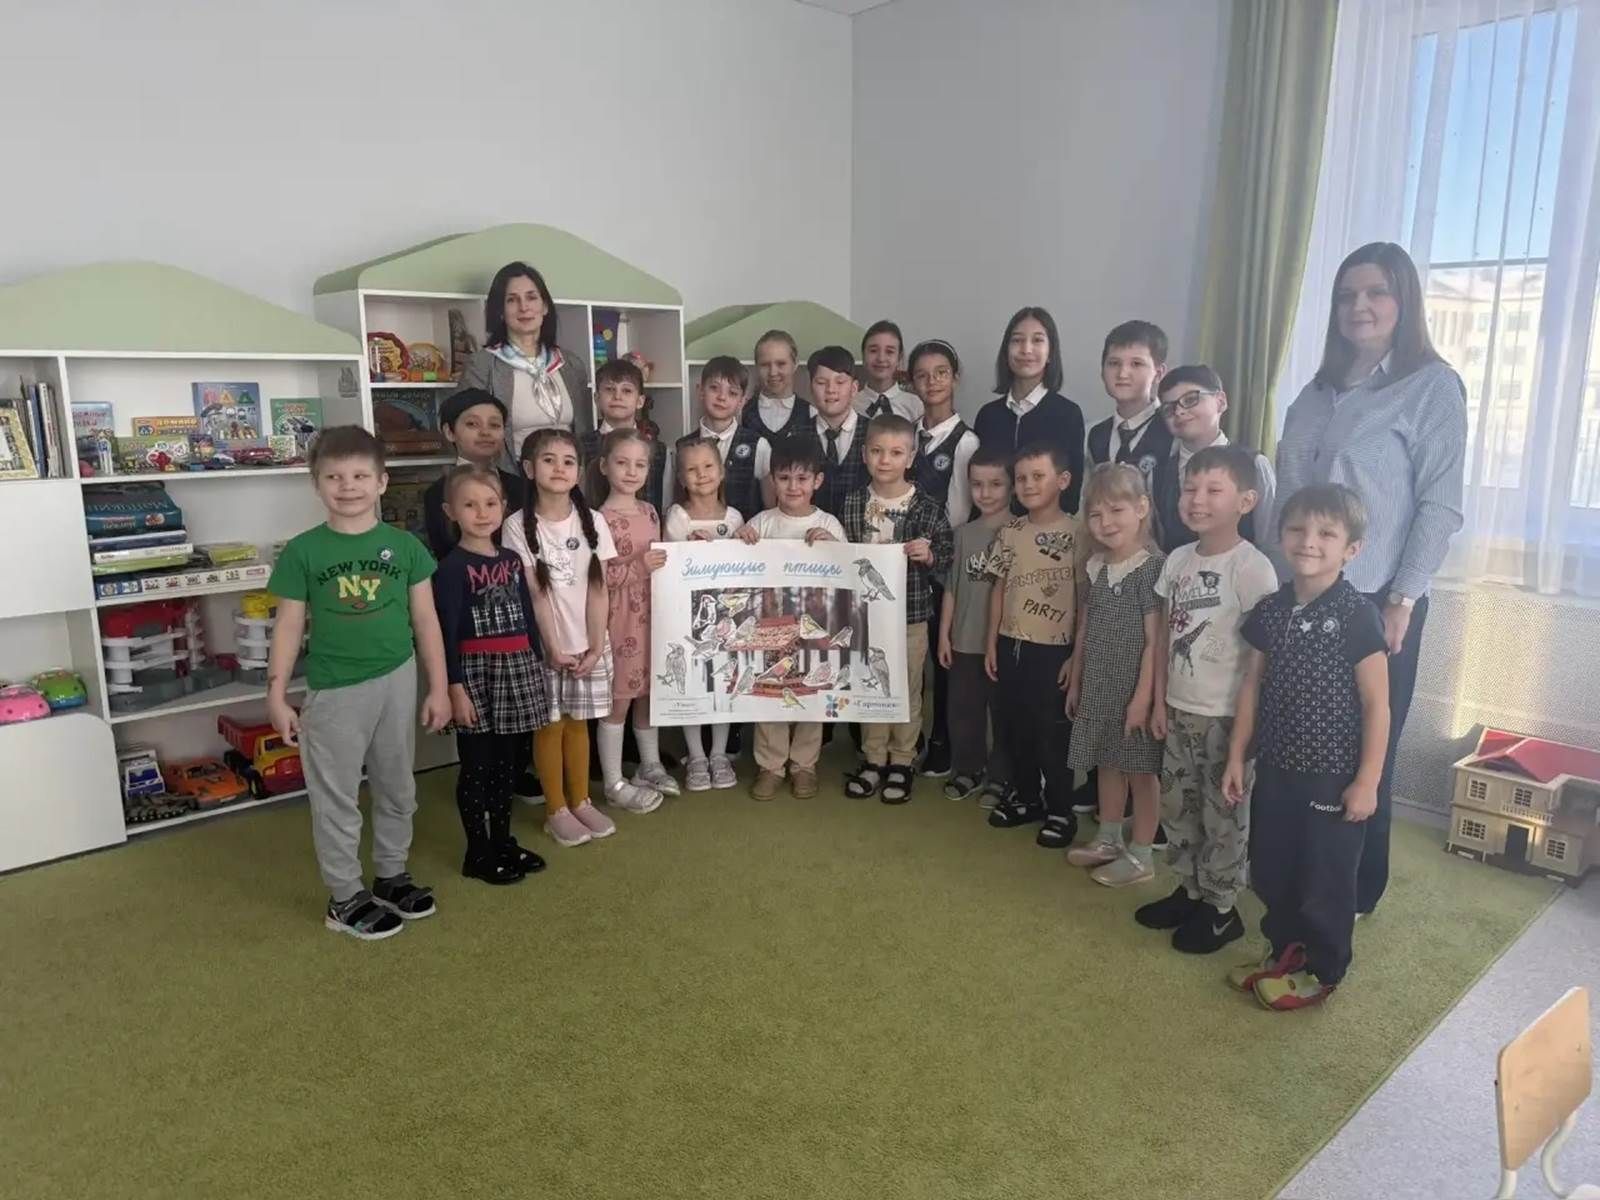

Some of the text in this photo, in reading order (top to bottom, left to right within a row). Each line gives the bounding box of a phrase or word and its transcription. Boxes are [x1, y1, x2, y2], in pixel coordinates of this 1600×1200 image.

[317, 560, 401, 586] NEW YORK
[682, 557, 842, 579] Зимующие птицы
[337, 575, 381, 601] NY
[1023, 599, 1067, 624] PARTY
[1309, 801, 1343, 812] Footba
